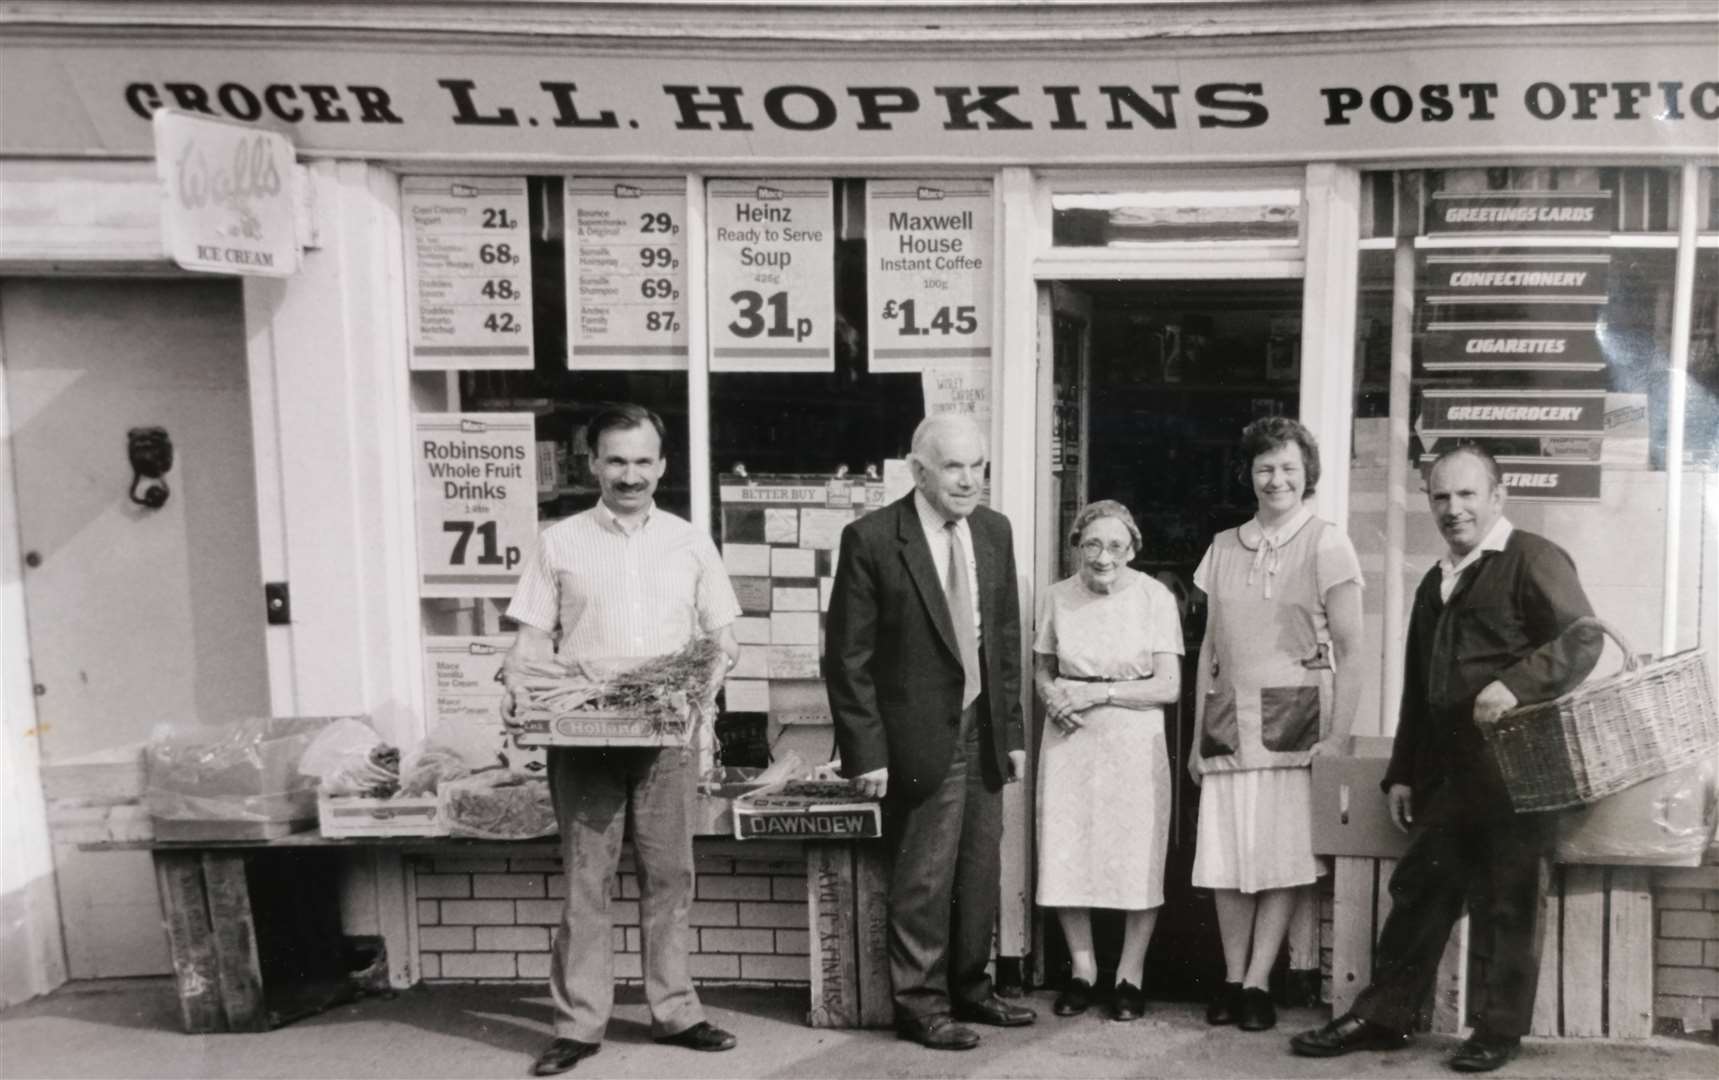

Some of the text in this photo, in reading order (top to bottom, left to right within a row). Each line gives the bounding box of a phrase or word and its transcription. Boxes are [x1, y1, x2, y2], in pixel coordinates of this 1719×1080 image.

[125, 82, 403, 123] GROCER
[438, 79, 640, 129] L.L.
[662, 81, 1269, 131] HOPKINS
[1320, 83, 1498, 125] POST
[482, 208, 518, 230] 21p
[736, 203, 793, 223] Heinz
[889, 210, 973, 231] Maxwell
[1446, 207, 1595, 222] GREETINGS CARDS
[640, 212, 680, 236] 29p
[717, 226, 823, 244] Ready to Serve
[899, 234, 963, 254] House
[197, 245, 274, 267] ICE CREAM
[480, 243, 520, 266] 68p
[640, 247, 680, 270] 99p
[741, 247, 792, 270] Soup
[881, 255, 983, 271] Instant Coffee
[1449, 271, 1587, 287] CONFECTIONERY
[481, 279, 521, 301] 48p
[641, 278, 680, 301] 69p
[484, 312, 522, 334] 42p
[646, 311, 680, 333] 87p
[728, 290, 813, 343] 31p
[882, 298, 978, 336] £1.45
[1465, 338, 1567, 354] CIGARETTES
[1447, 406, 1583, 421] GREENGROCERY
[423, 440, 526, 460] Robinsons
[429, 462, 522, 479] Whole Fruit
[1501, 472, 1560, 488] ETRIES
[444, 481, 506, 500] Drinks
[742, 488, 789, 500] BETTER
[792, 488, 817, 500] BUY
[443, 520, 521, 570] 71p
[570, 720, 642, 735] Holland
[750, 815, 865, 834] DAWNDEW
